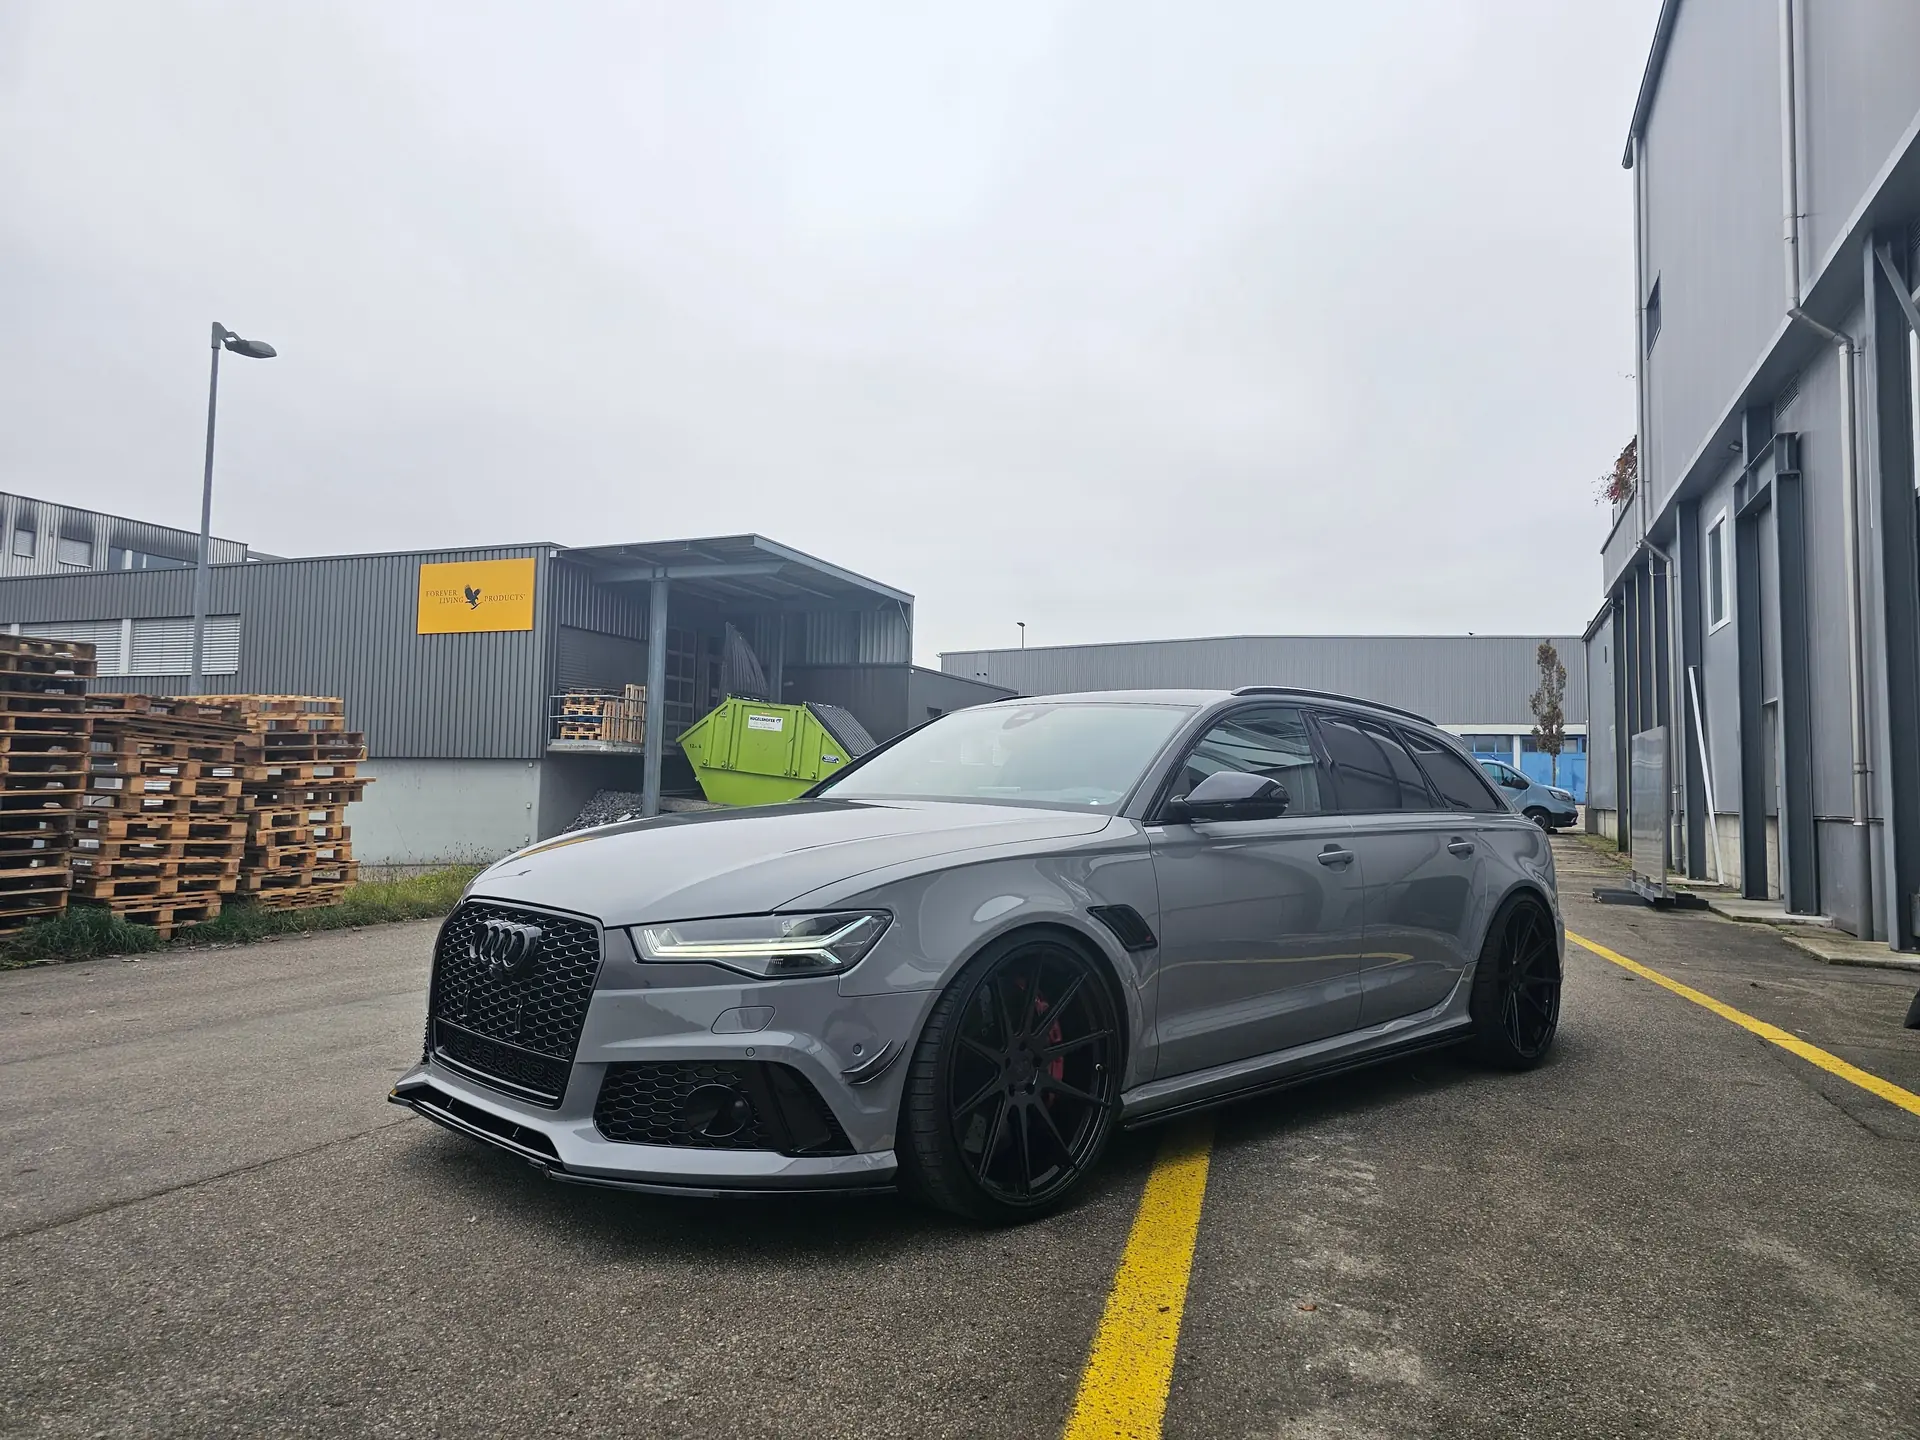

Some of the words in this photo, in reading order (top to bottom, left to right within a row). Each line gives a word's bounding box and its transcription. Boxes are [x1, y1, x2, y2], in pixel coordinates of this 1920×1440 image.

[439, 596, 464, 604] LIVING
[484, 594, 524, 602] PRODUCTS
[457, 1034, 545, 1076] quattro
